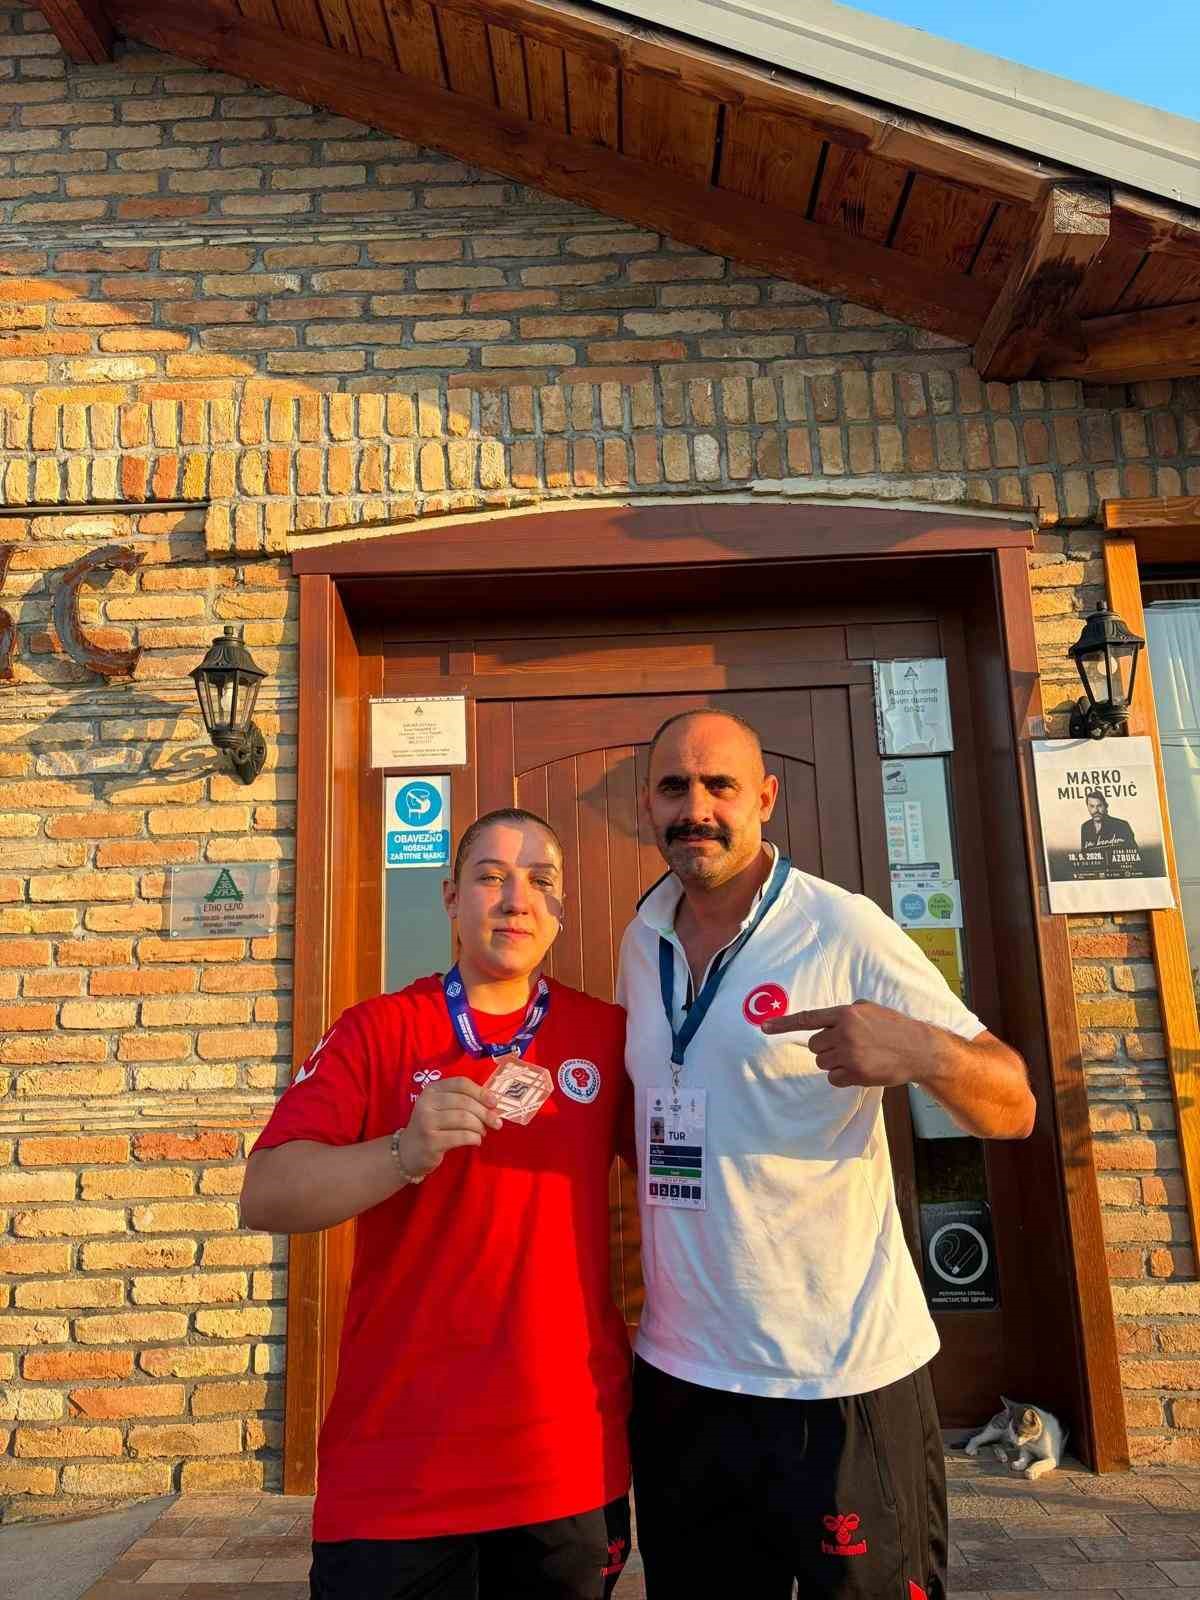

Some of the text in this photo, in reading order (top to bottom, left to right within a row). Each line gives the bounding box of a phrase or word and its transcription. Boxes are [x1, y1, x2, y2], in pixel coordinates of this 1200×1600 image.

[1066, 769, 1121, 785] MARKO
[394, 831, 443, 844] OBAVEZNO
[1112, 854, 1141, 863] AZBUKA
[668, 1131, 686, 1141] TUR
